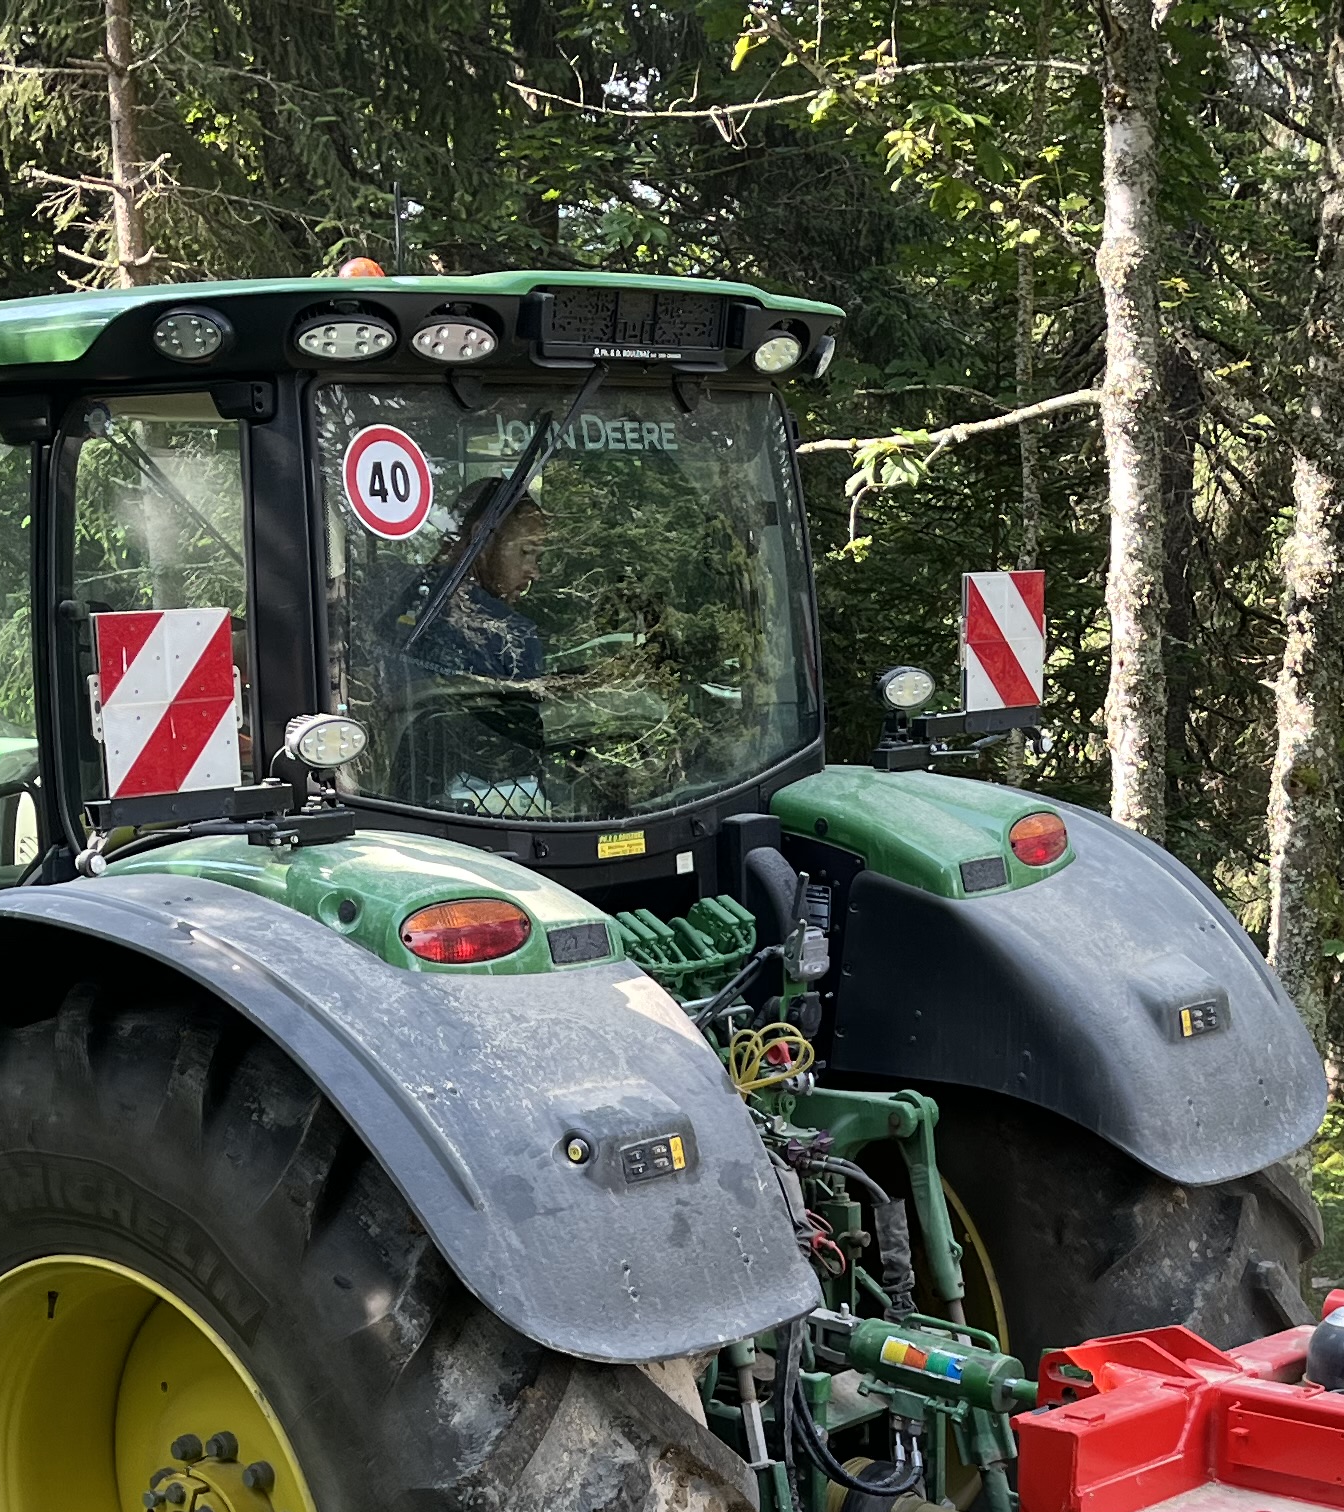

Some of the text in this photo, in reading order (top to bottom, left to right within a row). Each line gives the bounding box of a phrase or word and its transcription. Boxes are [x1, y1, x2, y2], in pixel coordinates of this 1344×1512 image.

[580, 414, 679, 450] DEERE
[369, 461, 411, 503] 40
[2, 1163, 259, 1330] MICHELIN
